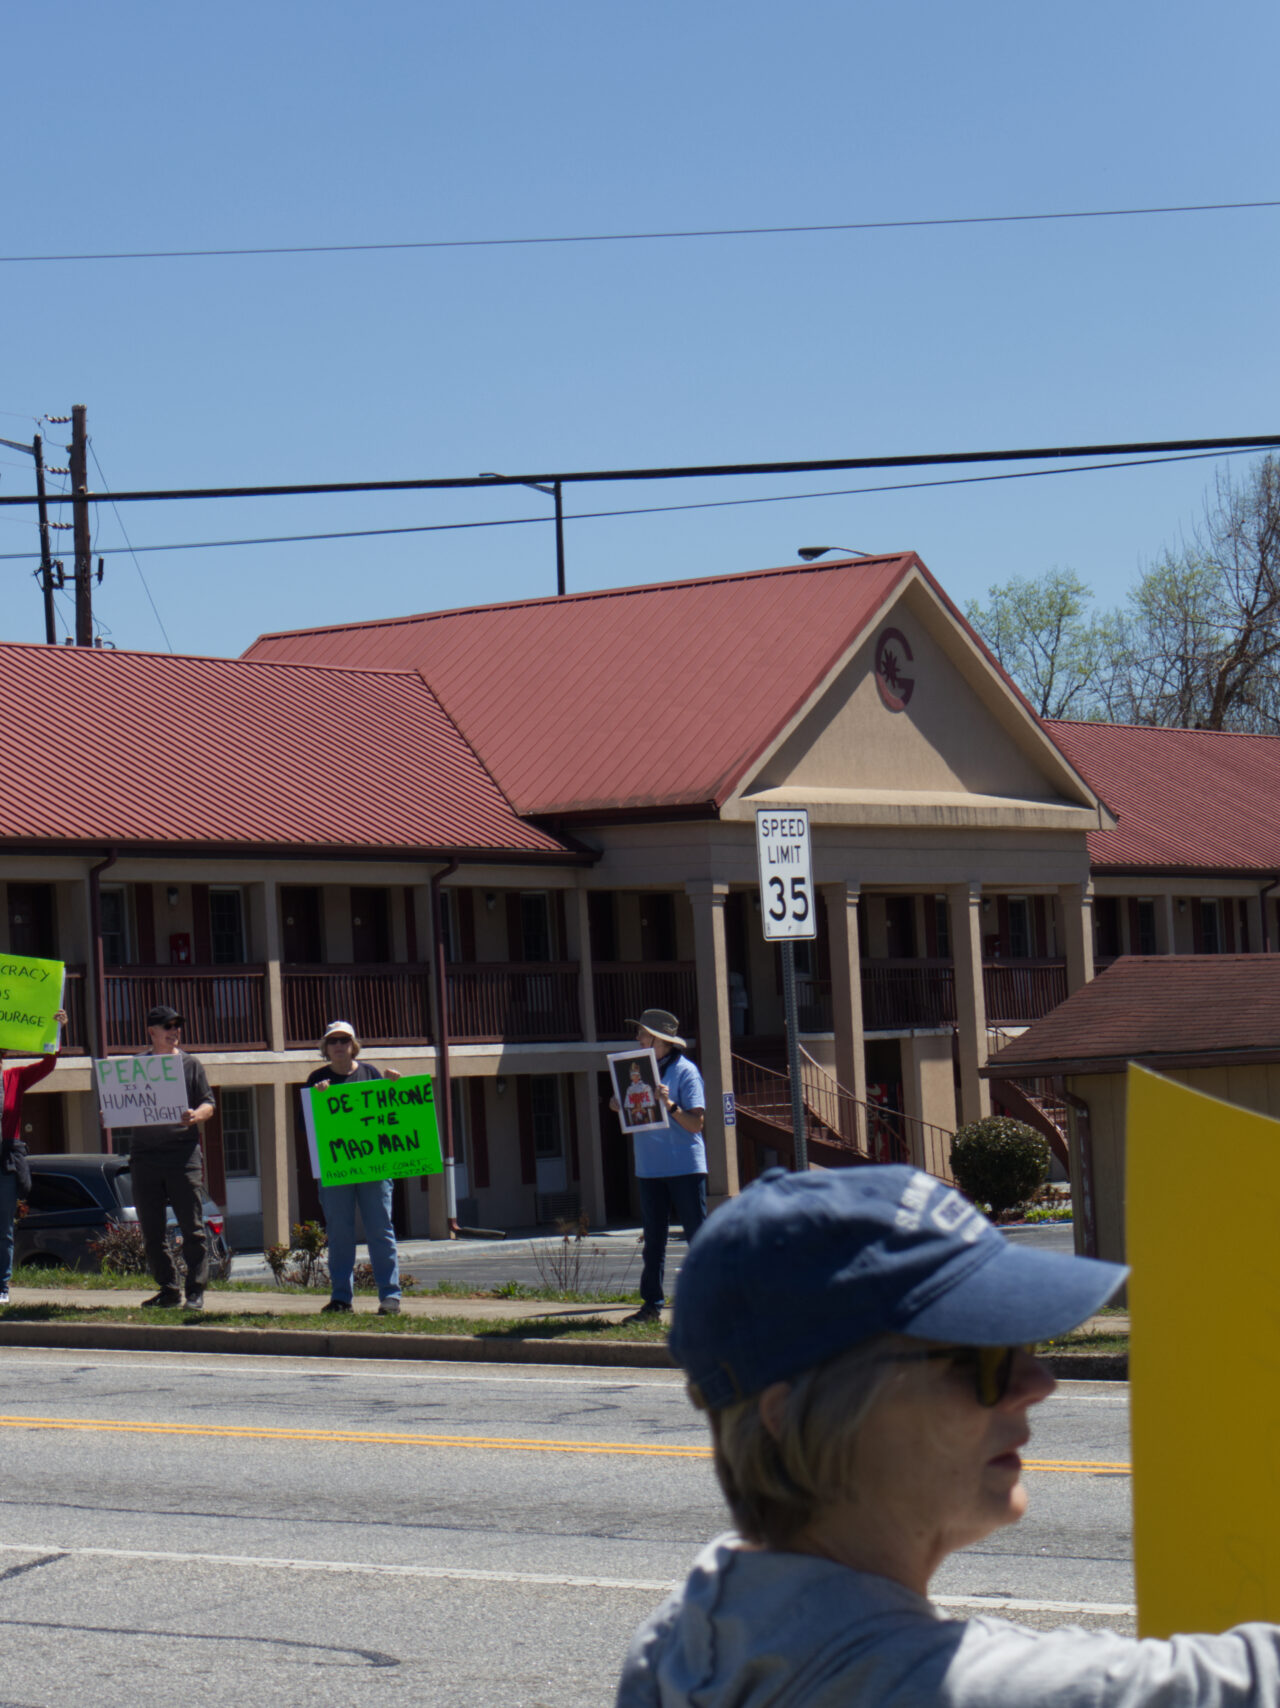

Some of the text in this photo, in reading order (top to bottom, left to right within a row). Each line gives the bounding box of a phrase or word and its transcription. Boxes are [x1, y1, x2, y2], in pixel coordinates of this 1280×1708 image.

[762, 818, 805, 837] SPEED
[768, 845, 801, 864] LIMIT
[769, 876, 809, 922] 35
[98, 1056, 178, 1084] PEACE
[123, 1082, 152, 1091] IS A
[102, 1092, 157, 1110] HUMAN
[327, 1083, 433, 1115] DE THRONE
[143, 1105, 185, 1123] RIGHT
[360, 1111, 399, 1127] THE
[326, 1169, 348, 1180] AND
[350, 1166, 364, 1175] ALL
[368, 1162, 388, 1174] THE
